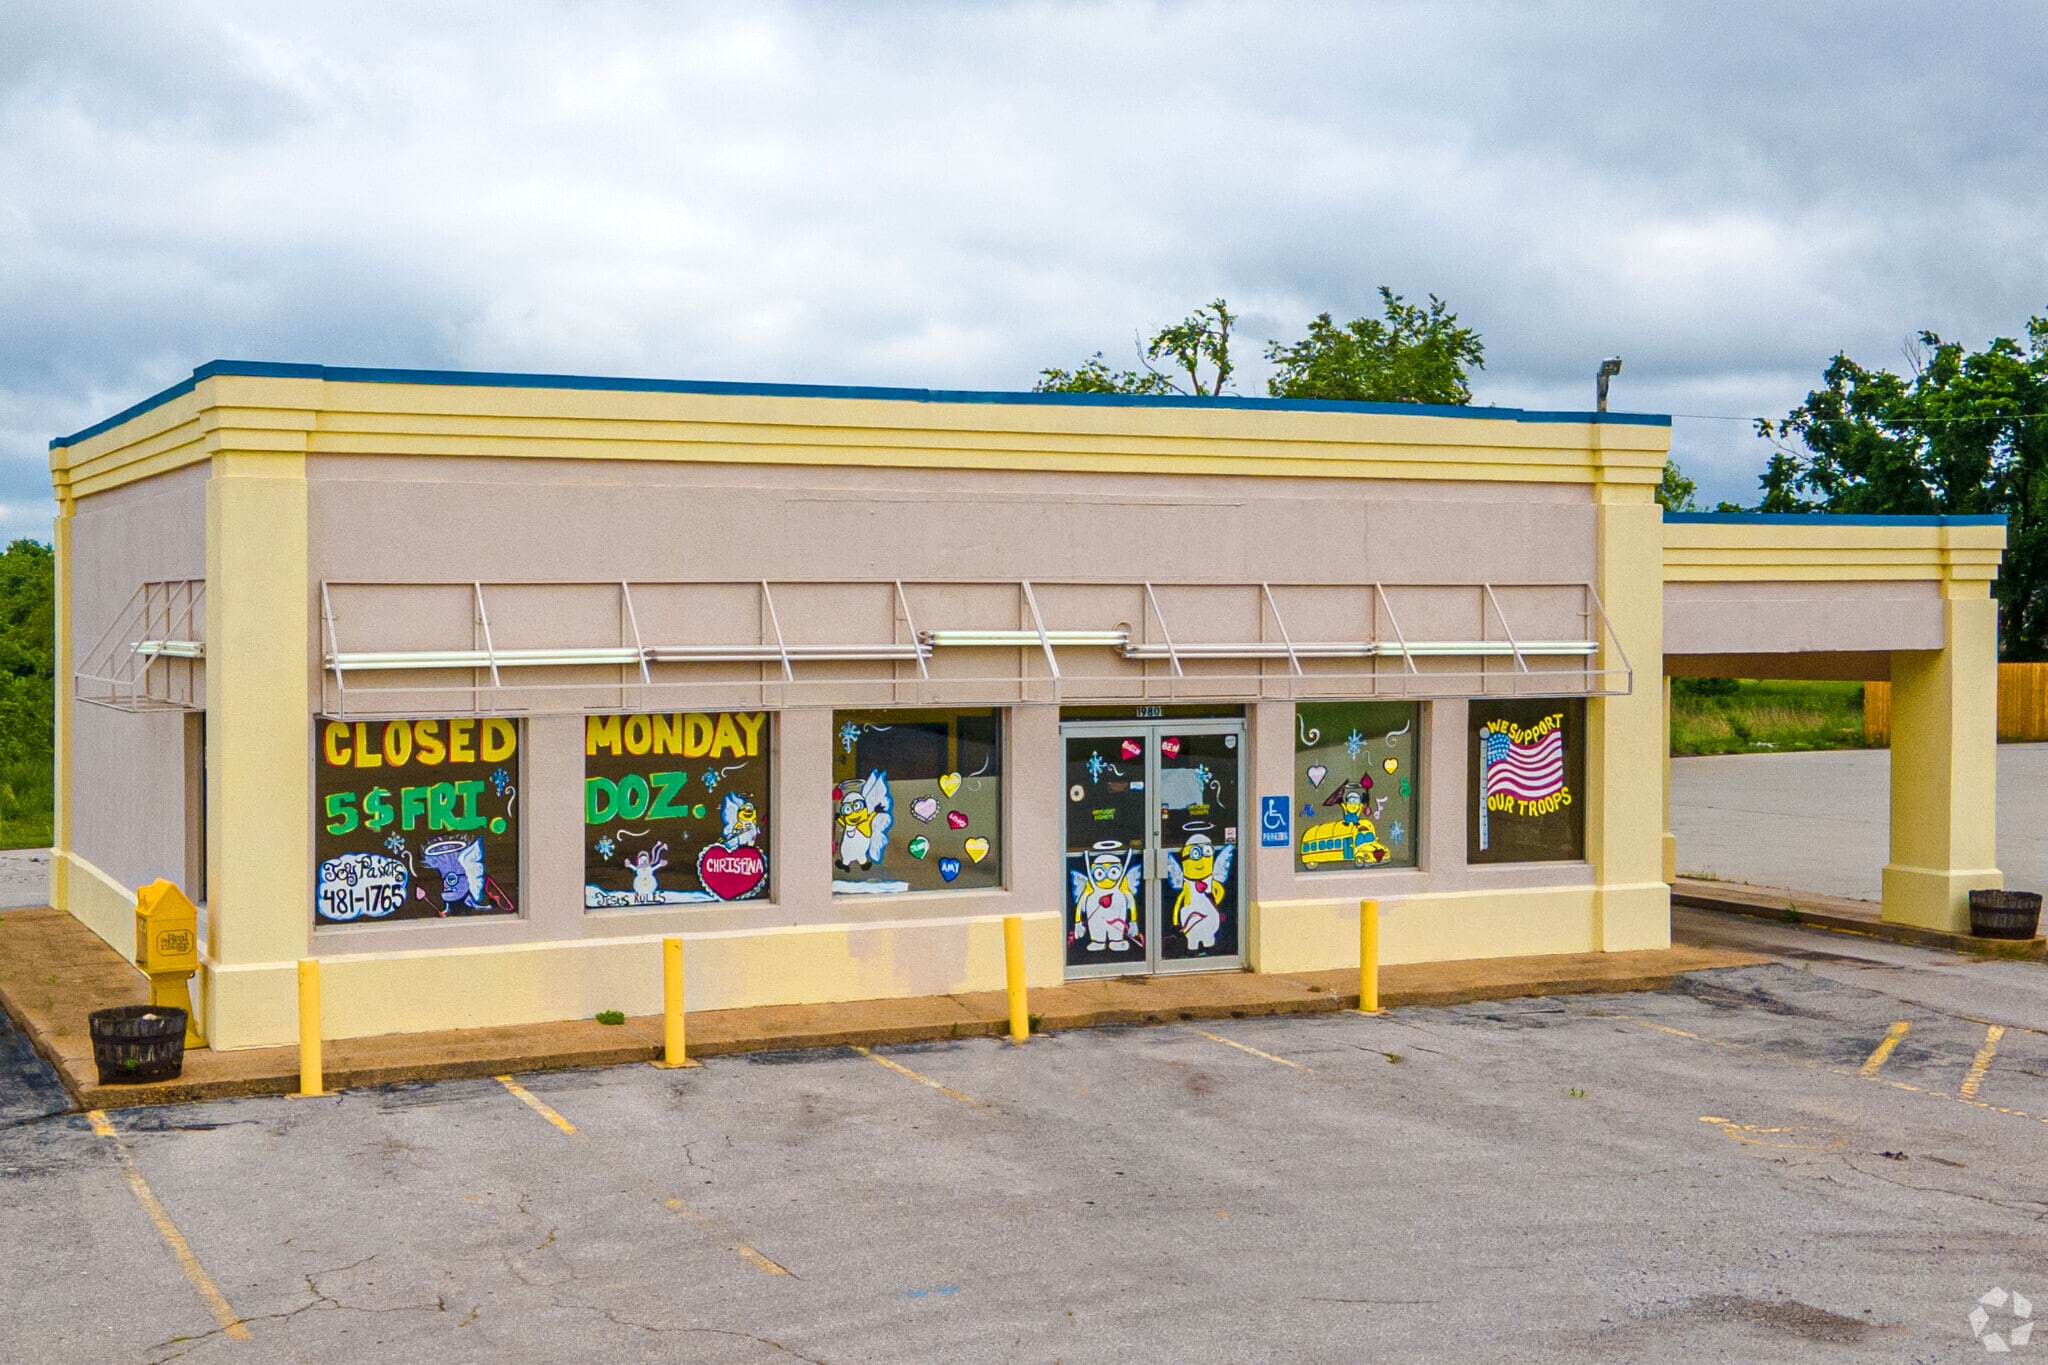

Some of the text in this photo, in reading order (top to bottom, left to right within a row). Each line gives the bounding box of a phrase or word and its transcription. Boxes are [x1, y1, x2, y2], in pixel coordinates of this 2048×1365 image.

[323, 712, 767, 768] CLOSED MONDAY
[1487, 713, 1564, 746] WE SUPPORT
[1161, 741, 1180, 753] BEN
[585, 771, 707, 824] DOZ.
[1487, 786, 1572, 817] OUR TROOPS
[706, 857, 764, 875] CHRISTINA
[941, 862, 960, 873] AMY
[323, 884, 405, 914] 481-1765
[595, 892, 630, 906] JESUS
